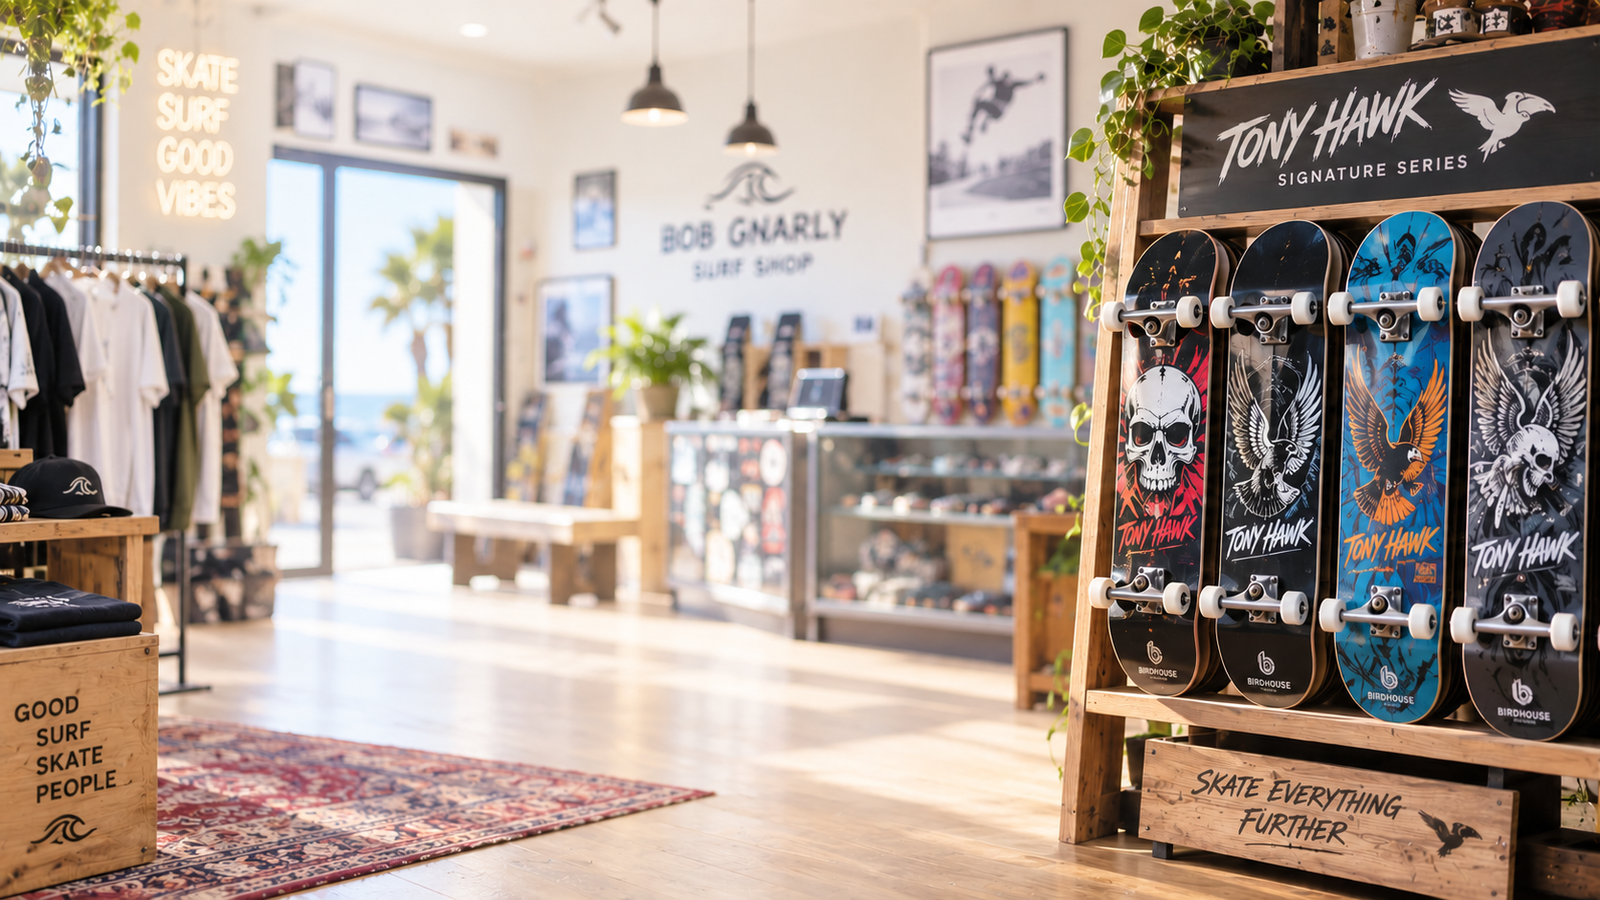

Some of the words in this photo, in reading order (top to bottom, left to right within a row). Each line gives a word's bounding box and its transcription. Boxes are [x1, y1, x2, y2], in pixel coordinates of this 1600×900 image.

[156, 48, 240, 94] SKATE
[156, 92, 231, 134] SURF
[1217, 102, 1317, 186] TONY
[1311, 77, 1439, 161] HAWK
[156, 135, 234, 177] GOOD
[1278, 163, 1386, 187] SIGNATURE
[1397, 154, 1468, 175] SERIES
[156, 178, 237, 220] VIBES
[661, 220, 714, 254] BOB
[728, 209, 848, 248] GNARLY
[693, 257, 744, 281] SURF
[755, 252, 814, 277] SHOP
[1117, 519, 1151, 556] TONY
[1151, 514, 1198, 547] HAWK
[1225, 523, 1265, 560] TONY
[1262, 518, 1314, 552] HAWK
[1343, 531, 1387, 568] TONY
[1384, 526, 1440, 562] HAWK
[1472, 538, 1521, 576] TONY
[1518, 531, 1580, 570] HAWK
[1138, 666, 1178, 678] BIRDHOUSE
[1247, 677, 1291, 690] BIRDHOUSE
[14, 696, 80, 722] GOOD
[1367, 691, 1415, 705] BIRDHOUSE
[1497, 707, 1551, 721] BIRDHOUSE
[36, 720, 91, 747] SURF
[36, 746, 103, 776] SKATE
[36, 770, 117, 804] PEOPLE
[1191, 769, 1264, 799] SKATE
[1267, 779, 1402, 820] EVERYTHING
[1238, 808, 1348, 845] FURTHER
